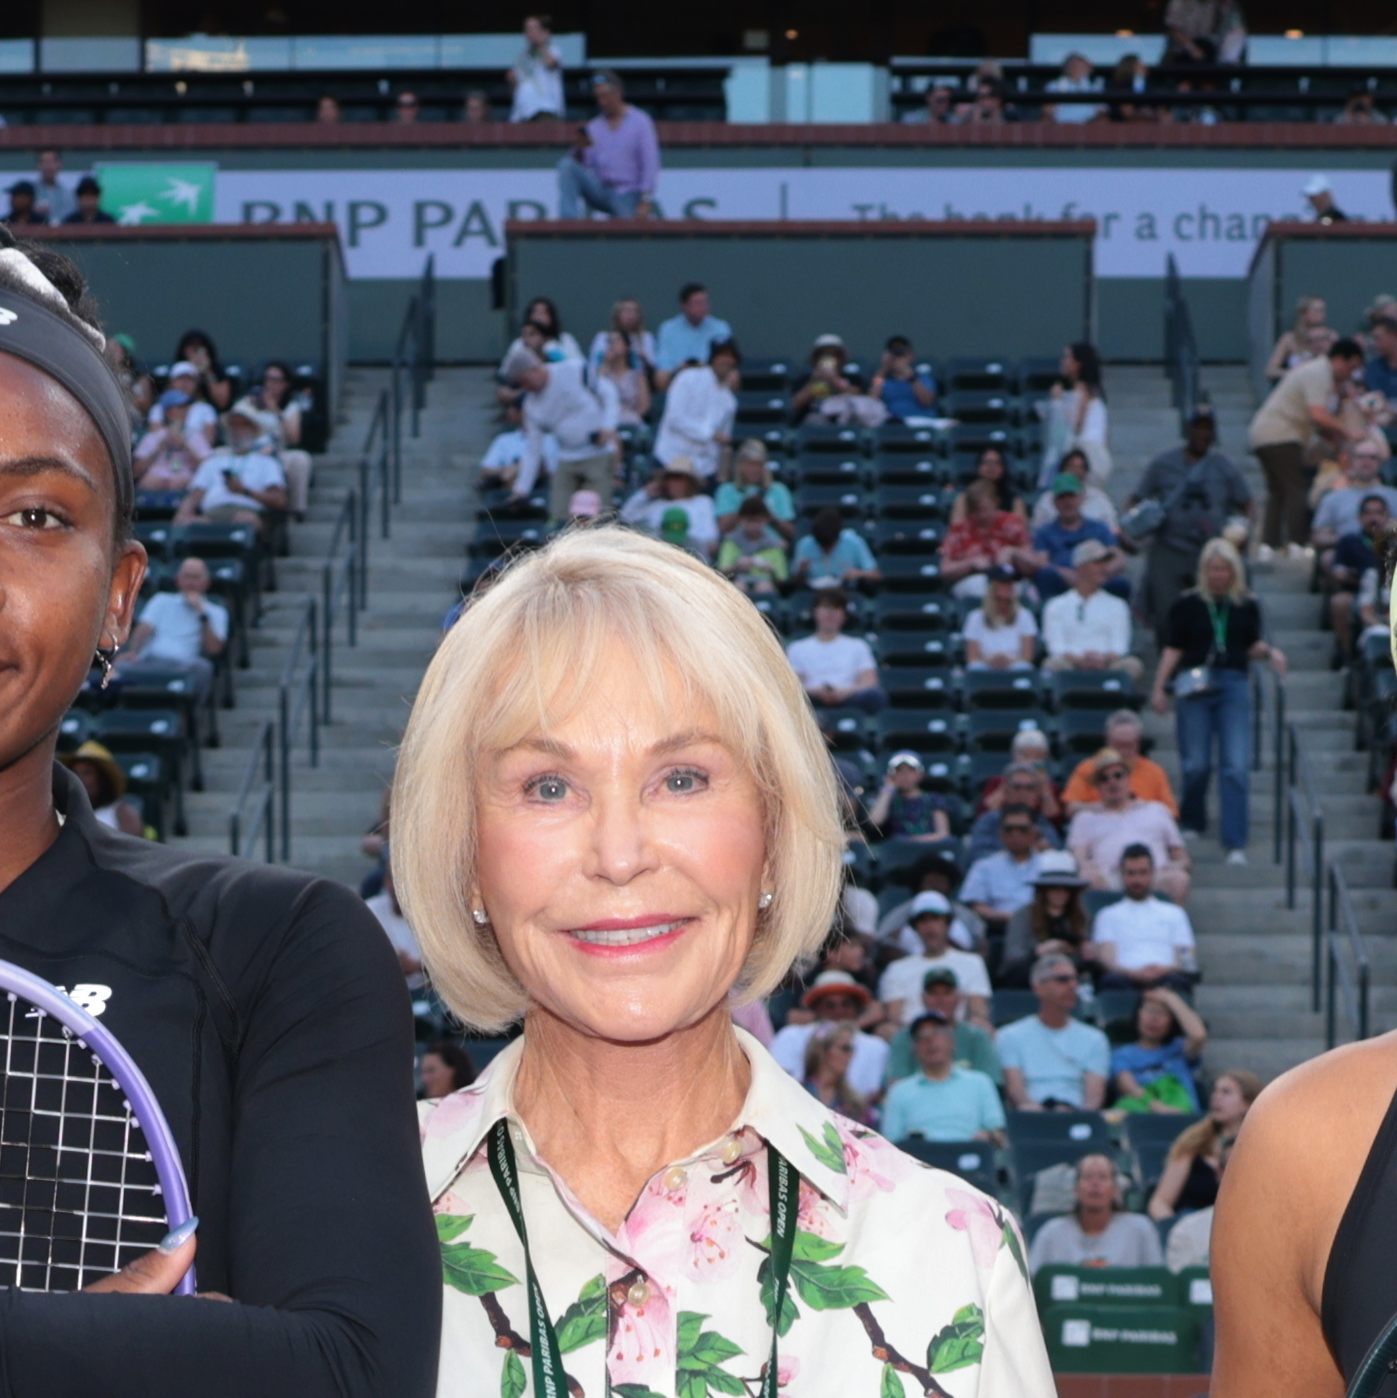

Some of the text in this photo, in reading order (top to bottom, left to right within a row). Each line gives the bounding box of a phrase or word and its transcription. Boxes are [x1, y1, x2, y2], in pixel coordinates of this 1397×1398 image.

[776, 1156, 789, 1238] ARIBAS OPEN
[537, 1319, 554, 1376] PARIBAS
